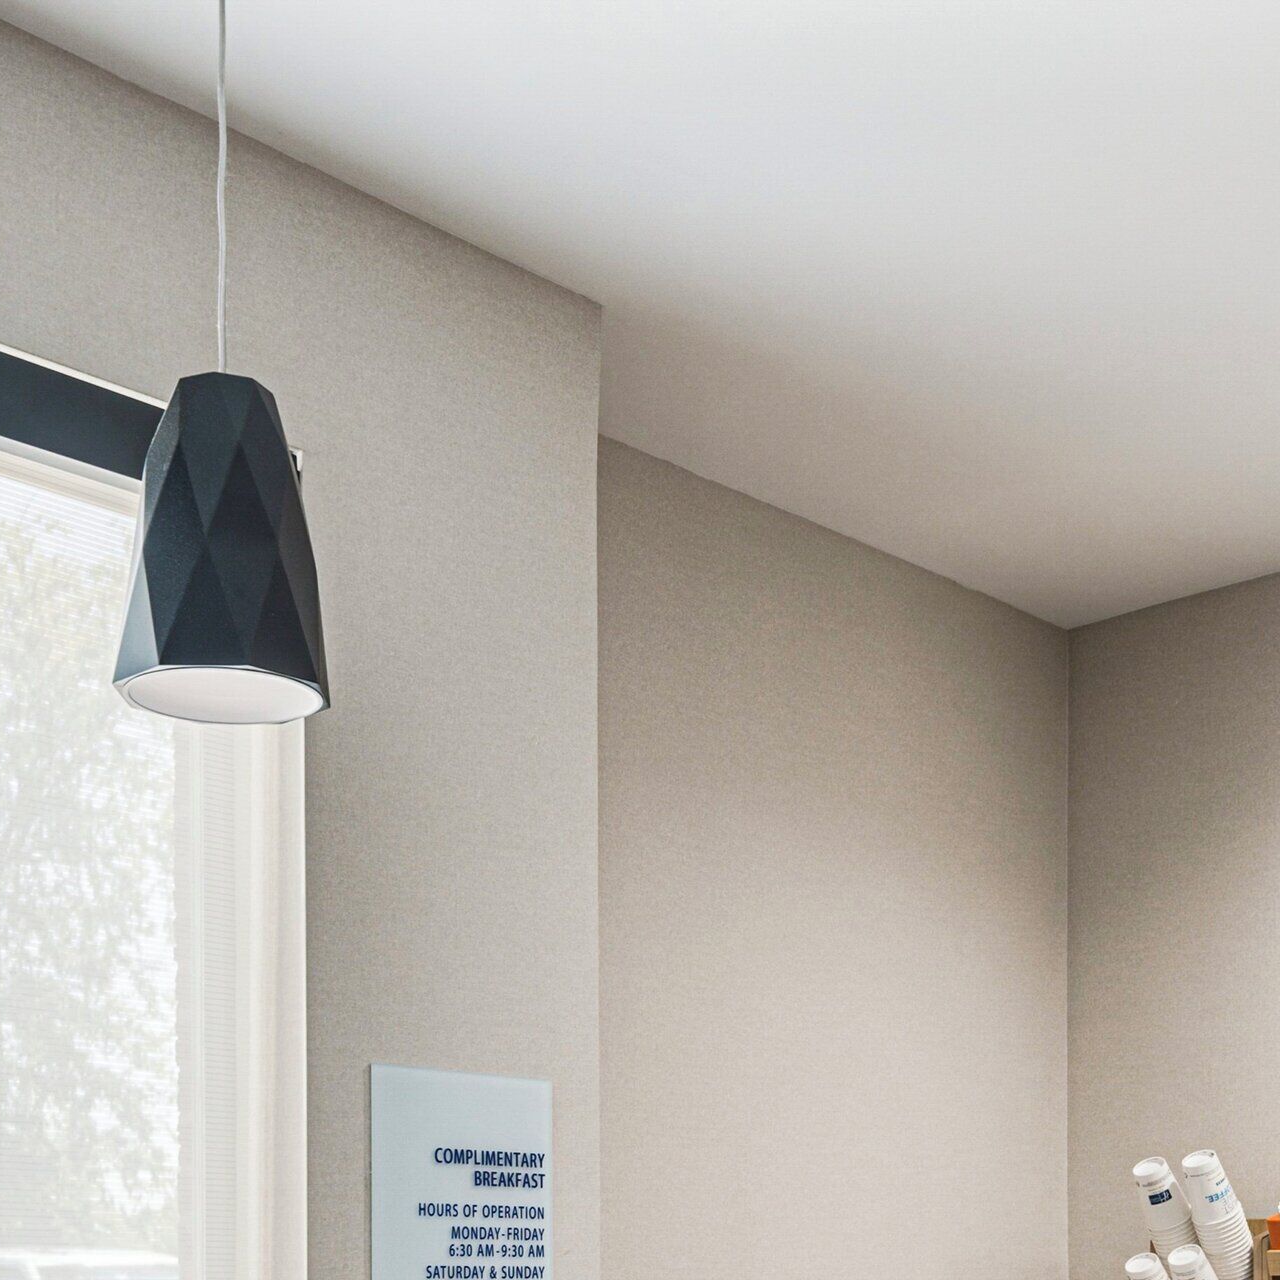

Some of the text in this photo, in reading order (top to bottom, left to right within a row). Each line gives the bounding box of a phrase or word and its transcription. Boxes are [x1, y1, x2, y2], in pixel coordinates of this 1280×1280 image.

[434, 1147, 545, 1168] COMPLIMENTARY
[474, 1171, 545, 1189] BREAKFAST
[418, 1203, 545, 1219] HOURS OF OPERATION
[450, 1226, 545, 1241] MONDAY-FRIDAY
[449, 1244, 473, 1257] 6:30
[528, 1245, 545, 1258] AM
[426, 1265, 545, 1279] SATURDAY & SUNDAY
